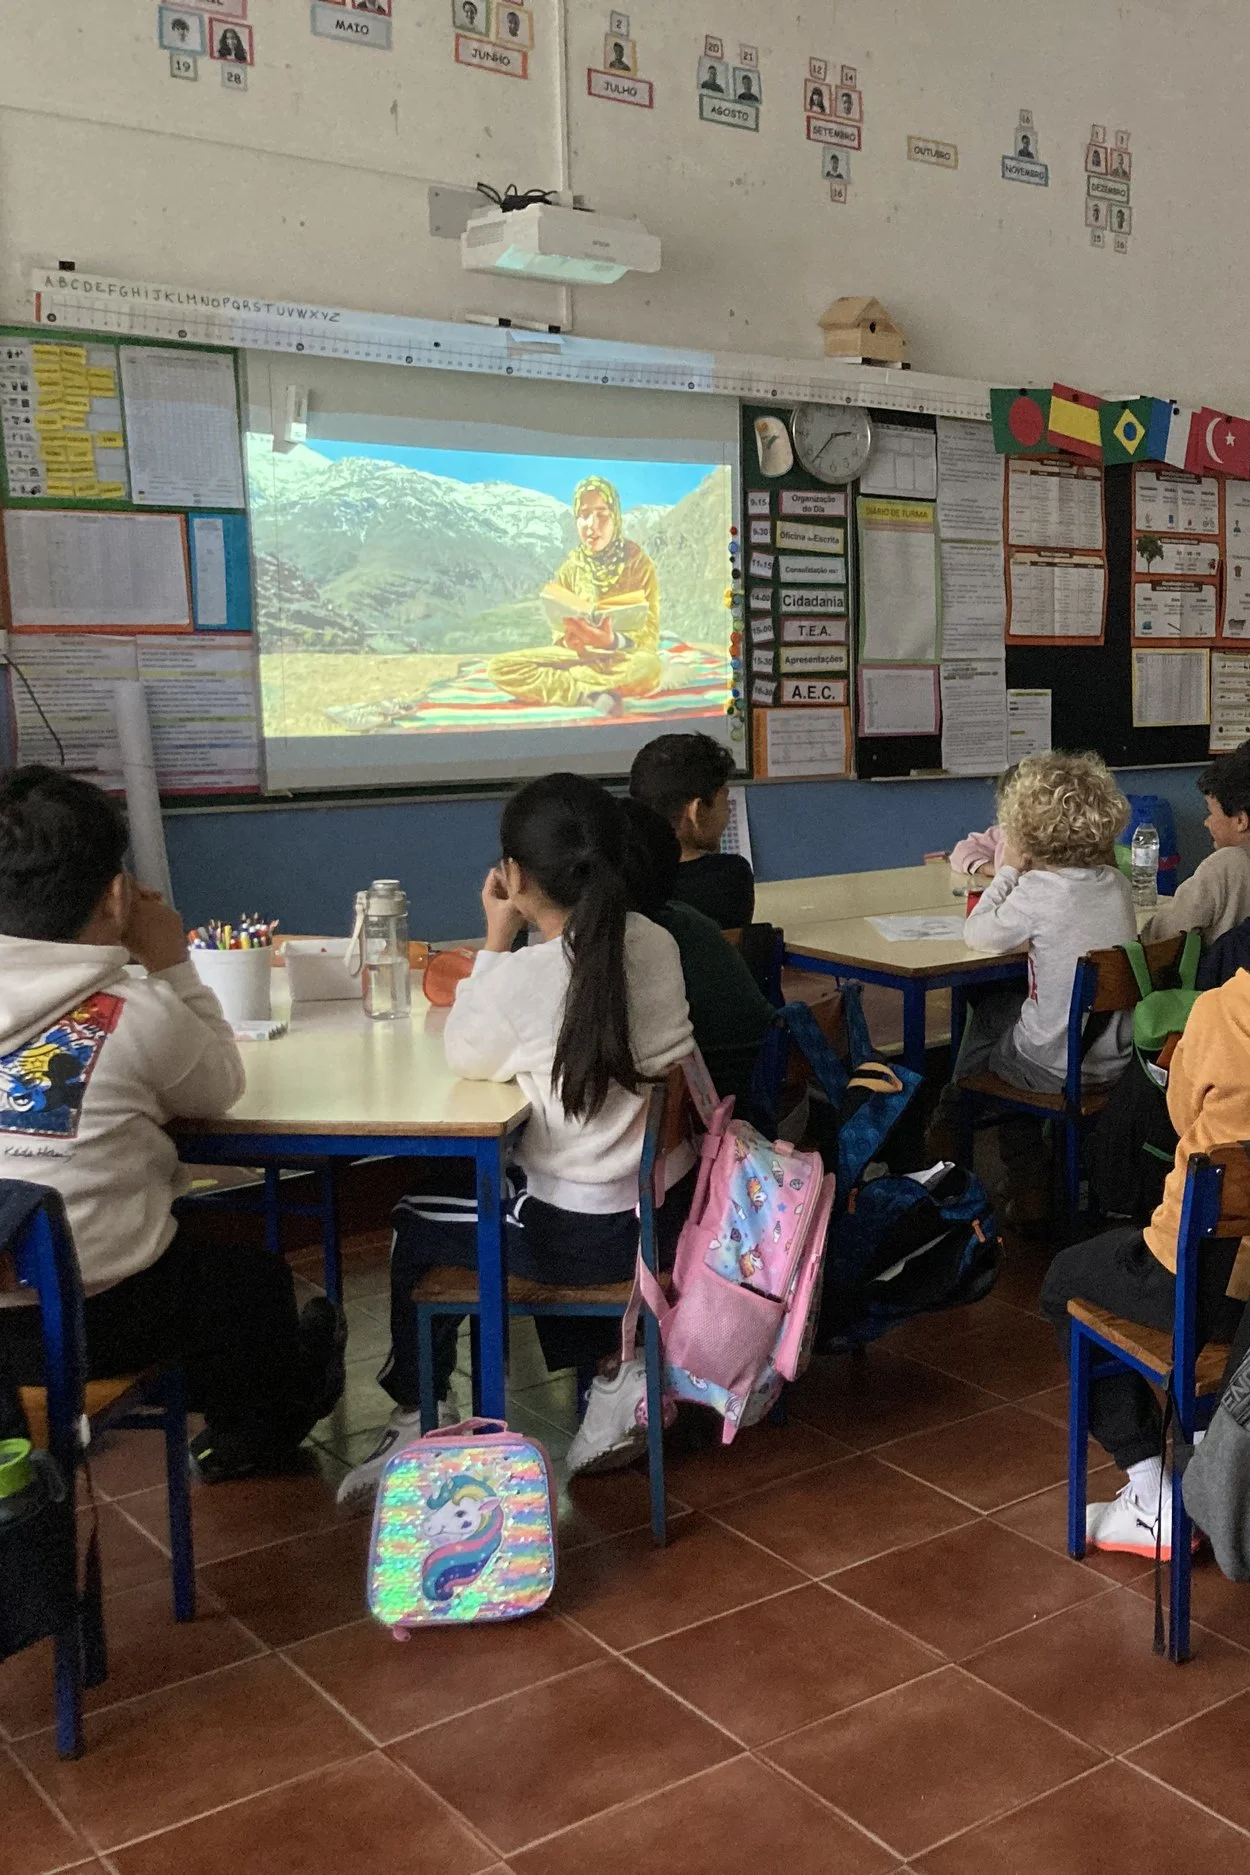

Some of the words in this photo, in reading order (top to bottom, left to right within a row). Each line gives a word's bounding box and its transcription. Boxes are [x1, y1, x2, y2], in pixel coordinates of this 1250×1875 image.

[335, 19, 370, 36] MAIO
[471, 48, 511, 67] JUNHO
[175, 60, 191, 73] 19
[813, 64, 822, 75] 12
[227, 72, 242, 85] 28
[603, 81, 638, 97] JULHO
[710, 105, 750, 122] AGOSTO
[812, 125, 856, 143] SETEMBRO
[913, 145, 951, 161] OUTUBRO
[1005, 163, 1045, 180] NOVEMBRO
[1091, 182, 1126, 197] DEZEMBRO
[791, 494, 836, 503] Organização
[903, 508, 928, 518] TURMA
[780, 531, 806, 541] Oficina
[814, 534, 840, 544] Escrita
[783, 594, 844, 607] Cidadania
[798, 625, 831, 636] T.E.A.
[785, 655, 844, 665] Apresentações
[792, 685, 835, 700] A.E.C.
